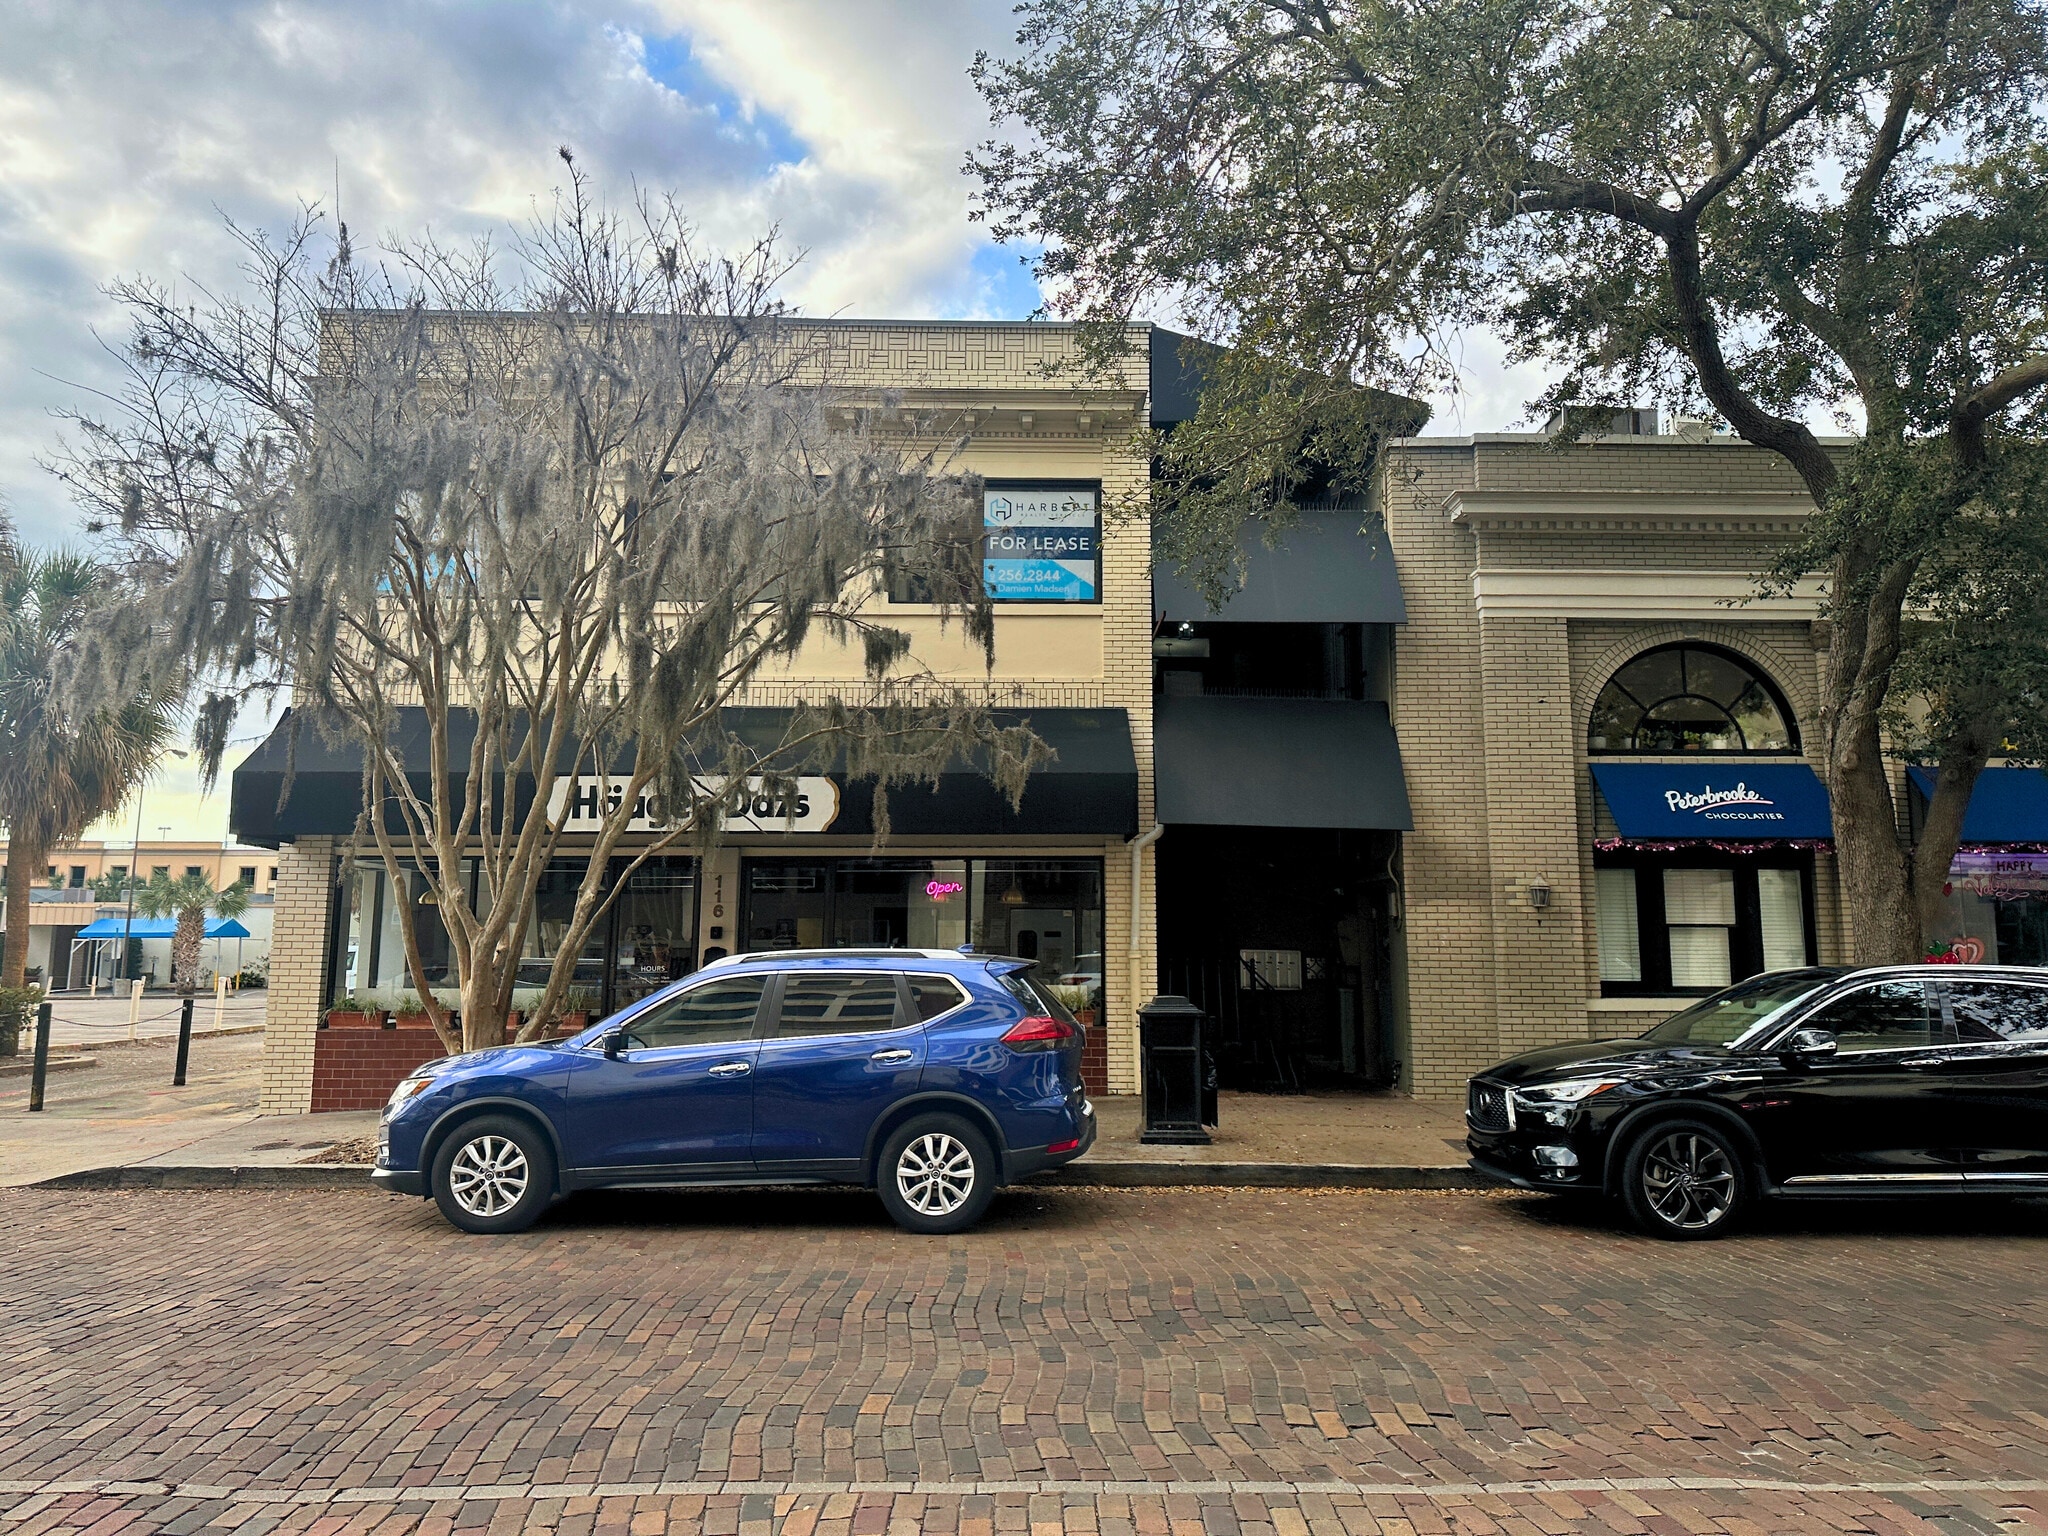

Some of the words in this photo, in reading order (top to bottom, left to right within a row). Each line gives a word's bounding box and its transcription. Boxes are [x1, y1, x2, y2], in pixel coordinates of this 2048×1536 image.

[989, 536, 1027, 550] FOR
[1034, 536, 1090, 551] LEASE
[998, 569, 1061, 582] 256.2844
[998, 584, 1033, 593] Damien
[1034, 584, 1070, 593] Madsen
[1664, 782, 1760, 812] Peterbrooke
[1705, 812, 1785, 820] CHOCOLATIER
[1996, 860, 2033, 872] HAPPY
[713, 874, 724, 918] 116
[926, 880, 963, 899] Open
